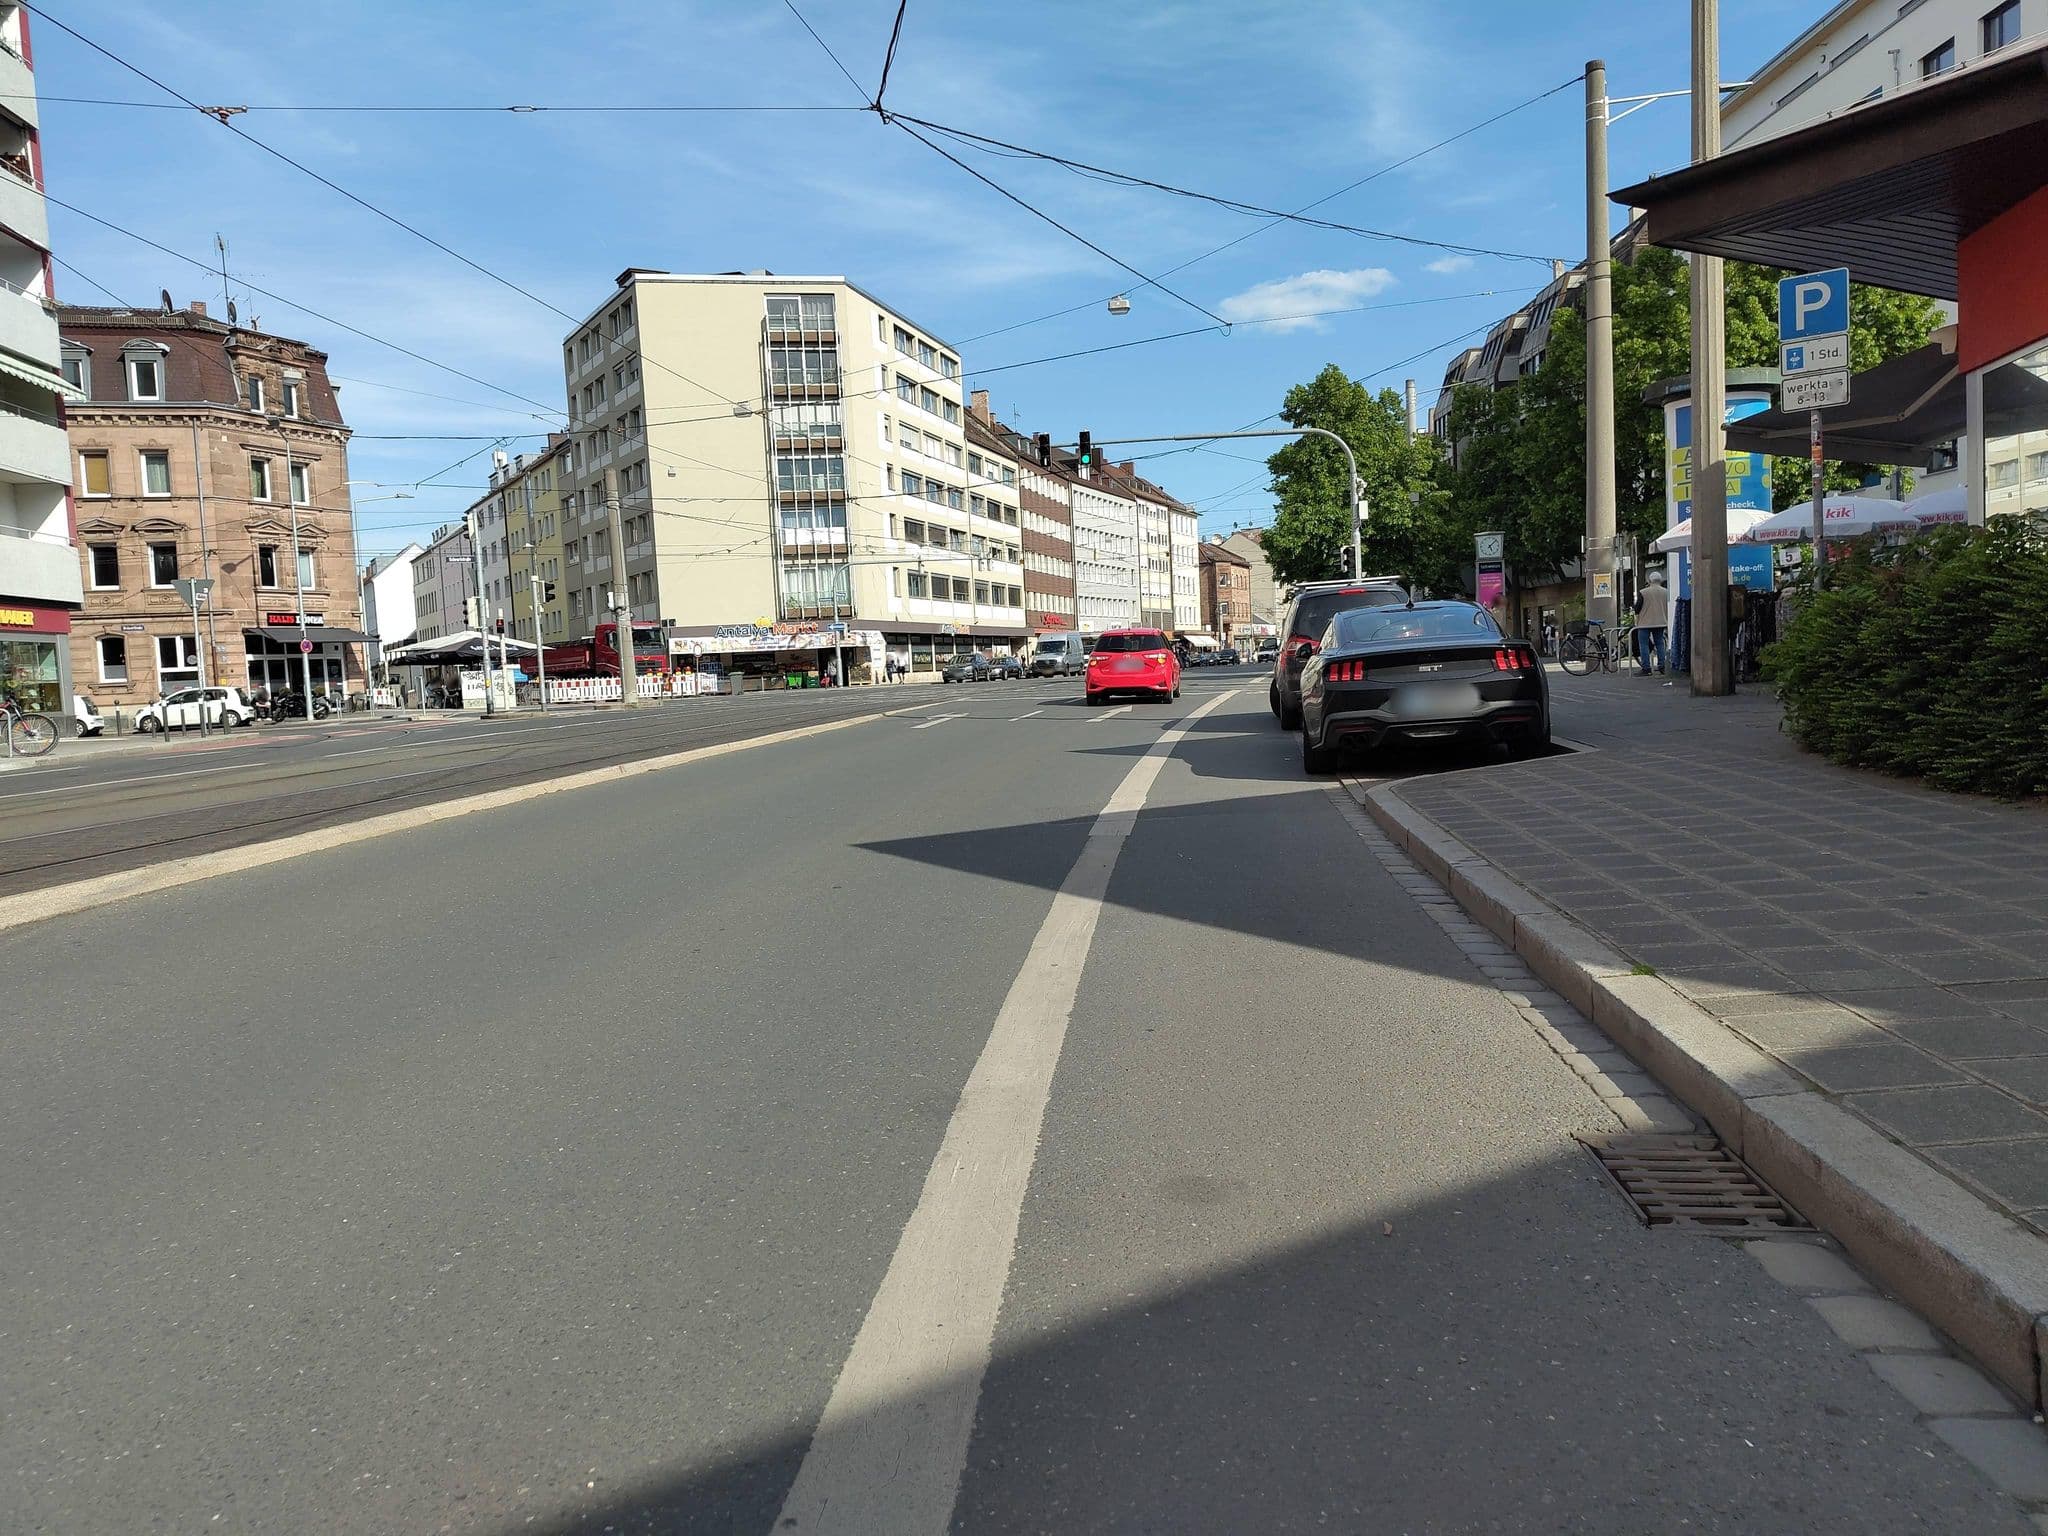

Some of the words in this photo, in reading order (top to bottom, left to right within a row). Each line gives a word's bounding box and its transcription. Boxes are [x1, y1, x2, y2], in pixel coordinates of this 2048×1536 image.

[1795, 281, 1831, 331] P
[1810, 351, 1815, 361] 1
[1818, 347, 1842, 360] Std.
[1787, 379, 1844, 394] werktas
[715, 624, 769, 639] Antalya
[772, 621, 819, 636] Markt
